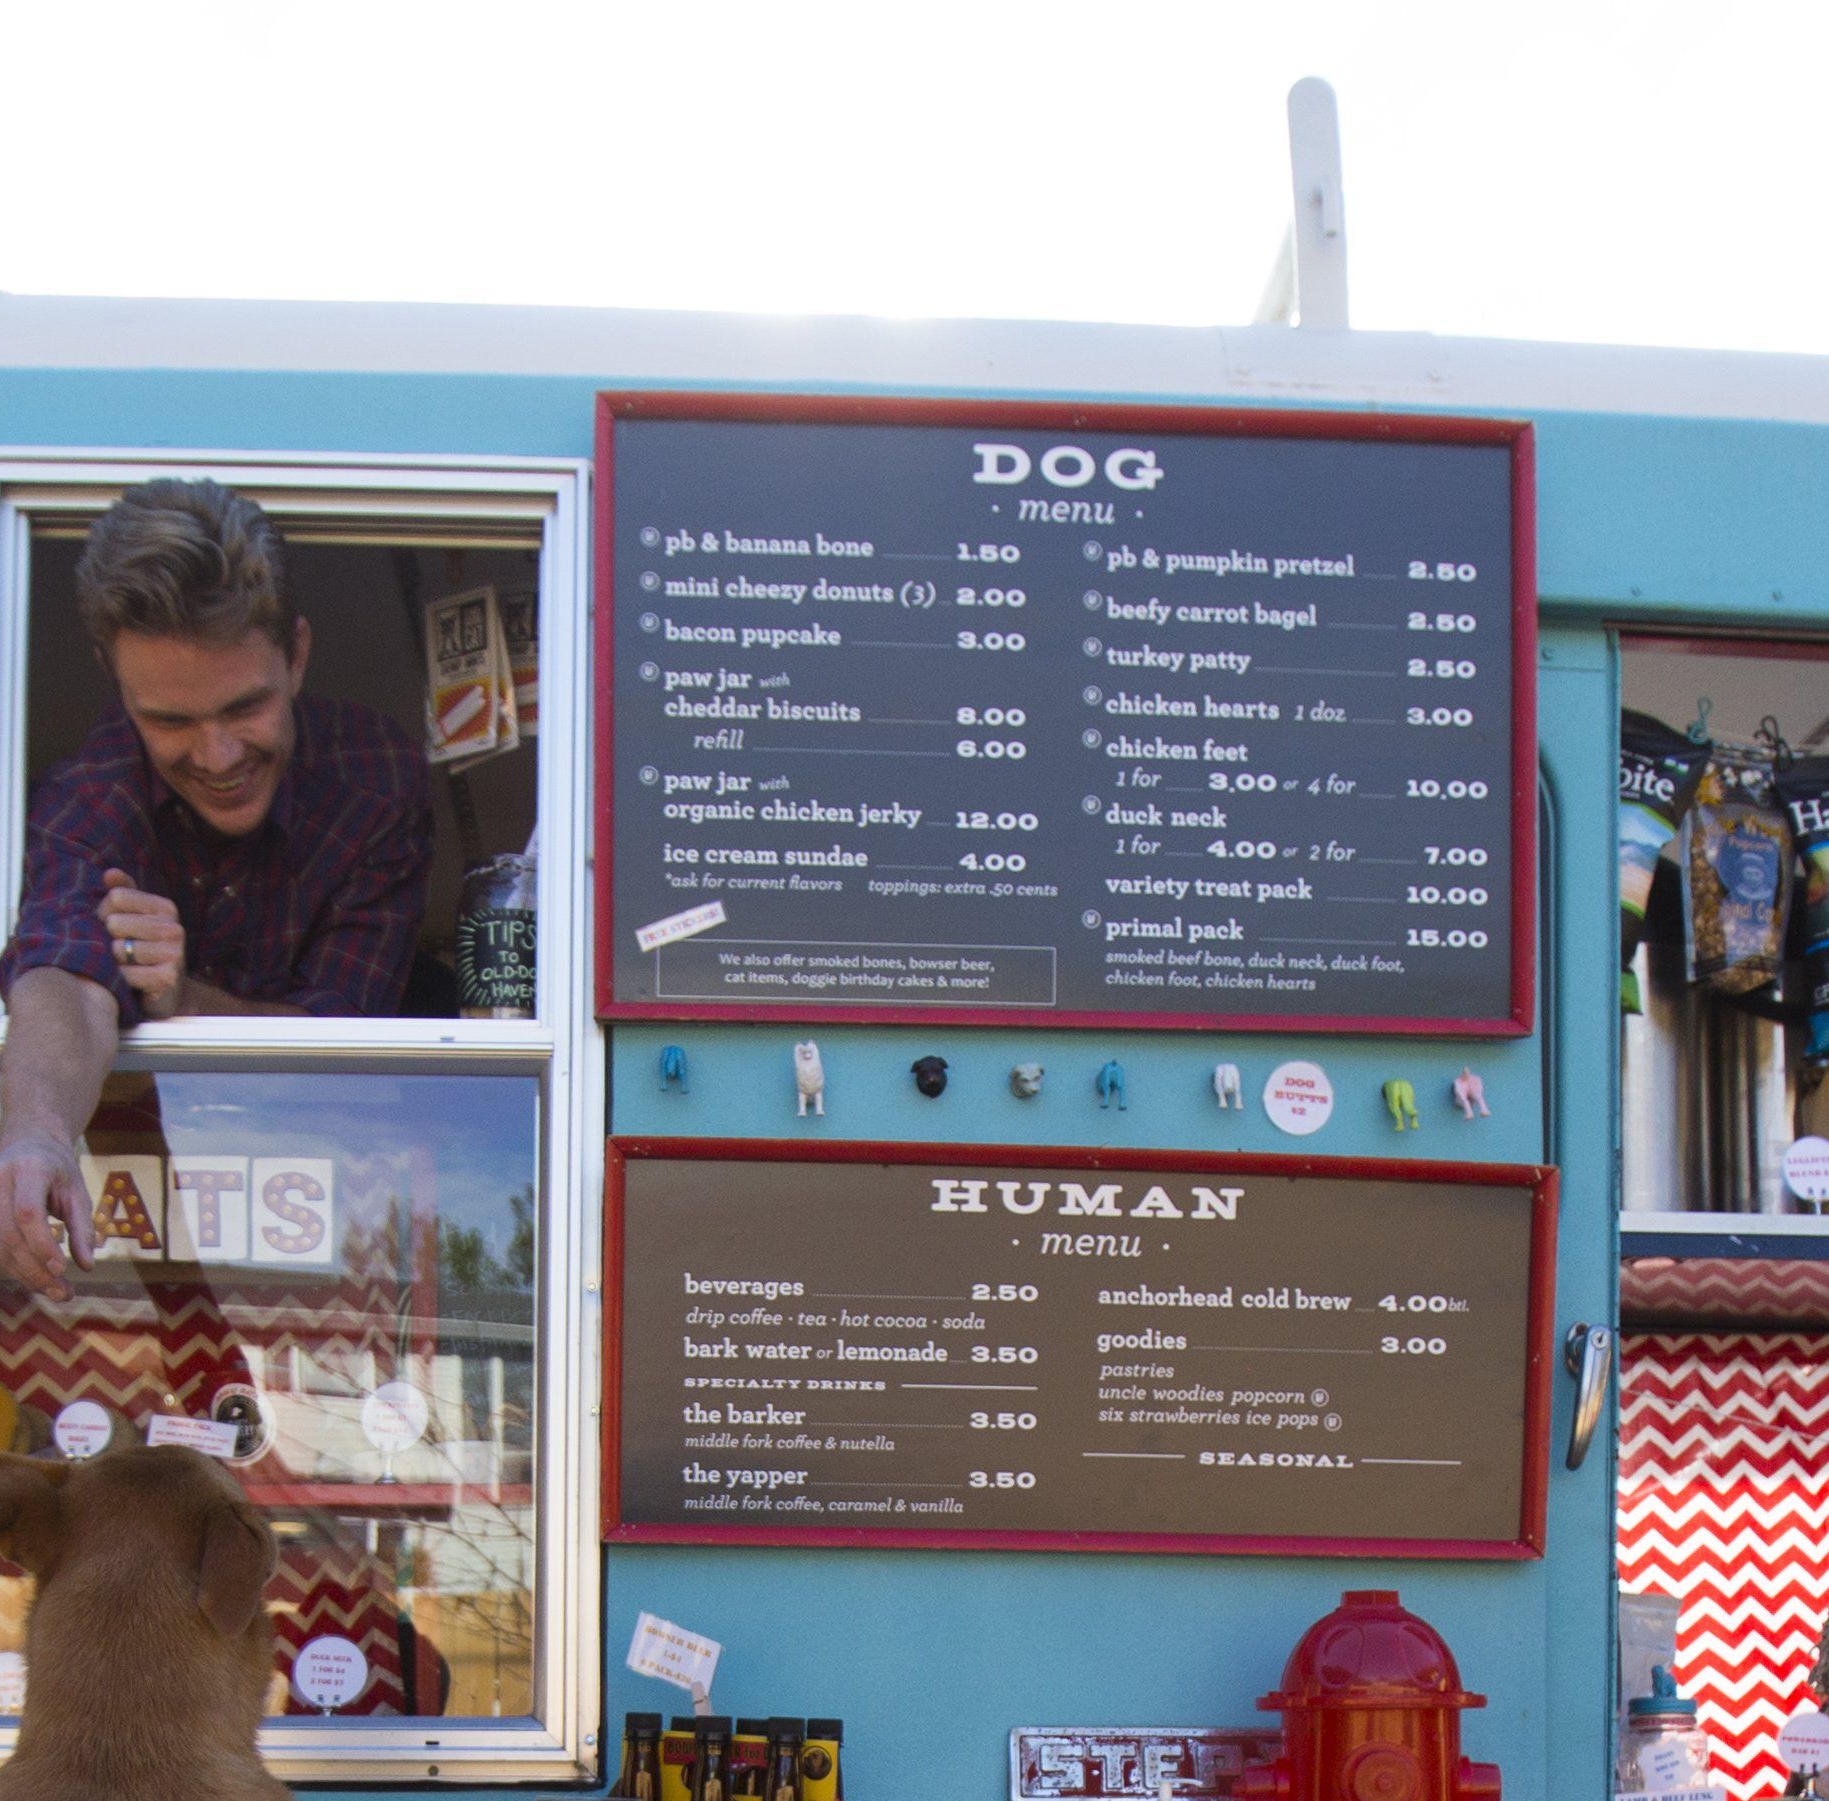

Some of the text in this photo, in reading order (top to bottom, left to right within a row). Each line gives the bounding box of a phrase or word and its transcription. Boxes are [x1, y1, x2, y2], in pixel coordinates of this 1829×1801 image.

[972, 443, 1165, 491] DOG
[1018, 499, 1115, 525] menu
[664, 528, 1021, 564] pb & banana bone 1.50
[1106, 544, 1477, 583] pb & pumpkin pretzel 2.50
[664, 574, 1027, 609] mini cheezy donuts (3) 2.00
[664, 618, 1026, 652] bacon pupcake 3.00
[1105, 643, 1477, 680] turkey patty 2.50
[663, 694, 1027, 727] cheddar biscuits 8.00
[1104, 691, 1474, 727] chicken hearts 1 doz 3.00
[693, 728, 1027, 760] refill 6.00
[663, 798, 1039, 832] organic chicken jerky 12.00
[1104, 801, 1227, 828] duck neck
[663, 842, 1027, 872] ice cream sundae 4.00
[867, 879, 1059, 898] toppings: extra .50 cents
[480, 919, 537, 950] TIPS
[1105, 915, 1489, 949] primal pack 15.00
[498, 950, 520, 964] TO
[1274, 1089, 1329, 1105] BUTTS
[1284, 1076, 1316, 1089] DOG
[930, 1179, 1245, 1221] HUMAN
[1040, 1232, 1142, 1258] menu
[683, 1272, 1039, 1303] beverages 2.50
[1097, 1283, 1353, 1311] anchorhead cold brew
[1096, 1327, 1448, 1356] goodies 3.00
[683, 1377, 887, 1392] SPECIALTY DRINKS
[1098, 1362, 1175, 1382] pastries
[1098, 1383, 1306, 1408] uncle woodies popcorn
[682, 1401, 1038, 1431] the barker 3.50
[1198, 1451, 1354, 1469] SEASONAL
[682, 1461, 1037, 1490] the yapper 3.50
